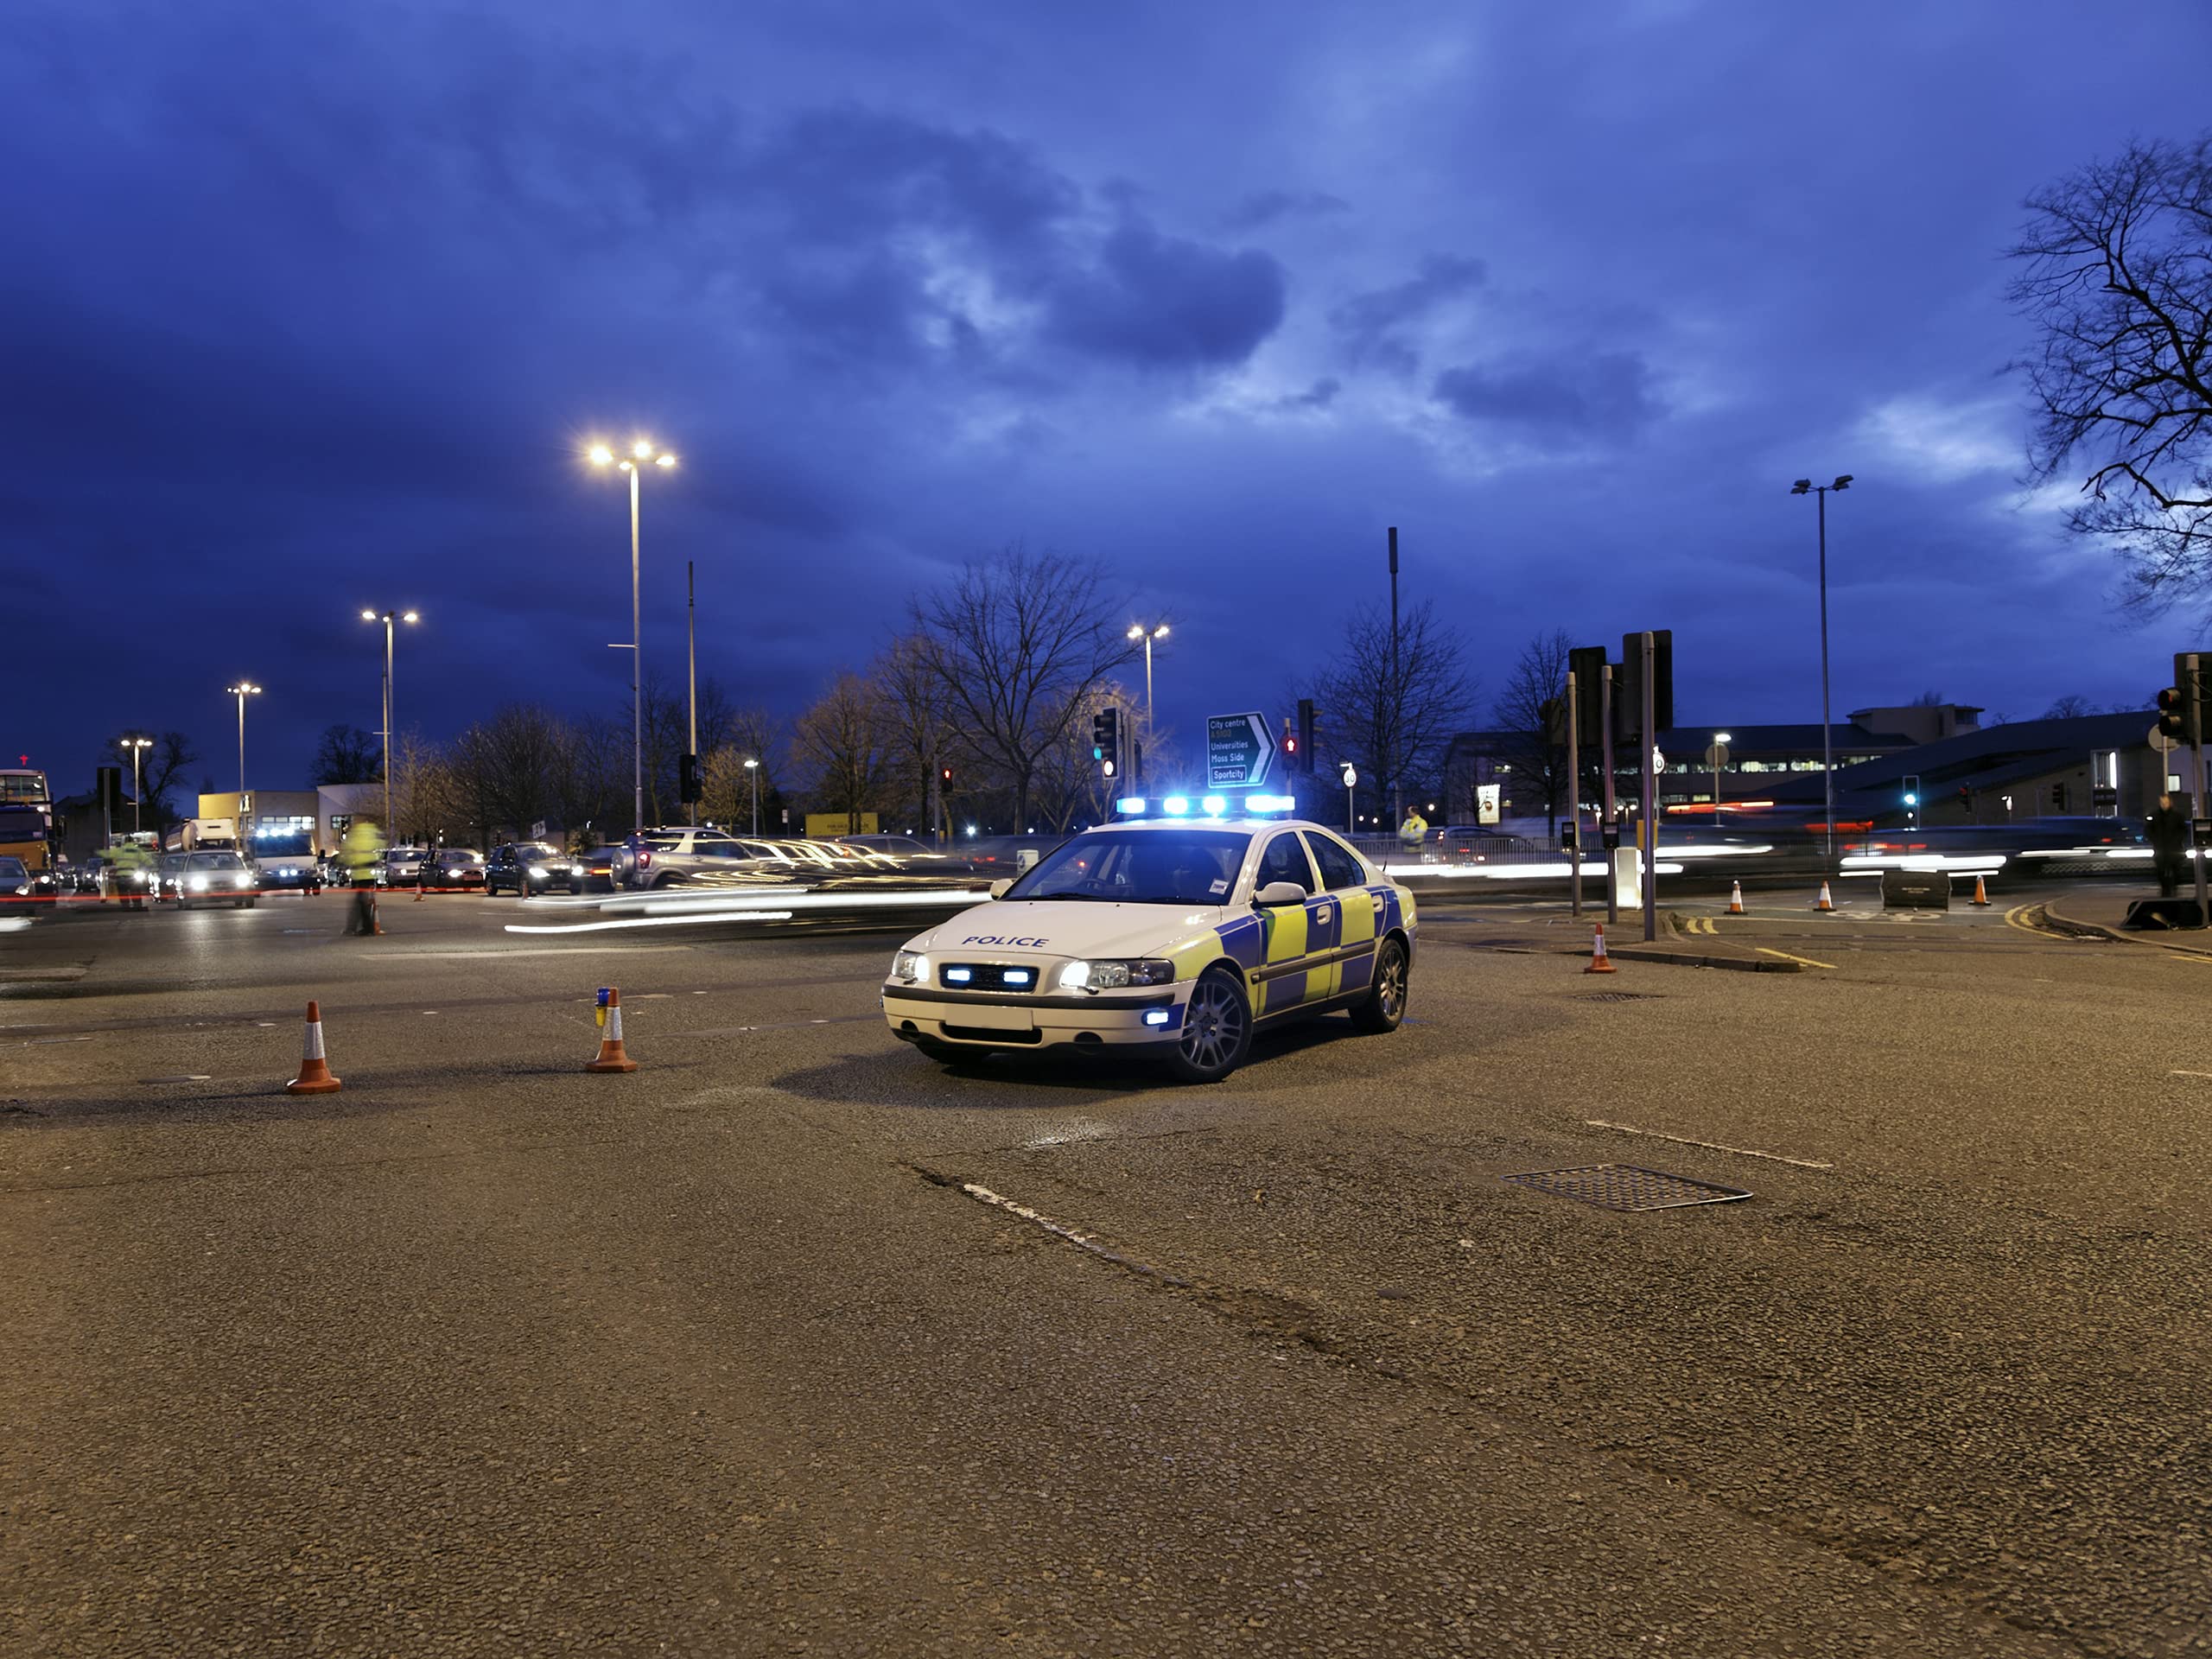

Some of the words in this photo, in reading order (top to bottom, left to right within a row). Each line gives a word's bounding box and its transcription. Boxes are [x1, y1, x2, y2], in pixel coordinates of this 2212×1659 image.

[1210, 719, 1224, 729] City
[1225, 718, 1246, 728] centre
[1211, 741, 1249, 751] Universities
[1211, 754, 1228, 763] Moss
[1230, 753, 1245, 762] Side
[1213, 770, 1244, 780] Sportcity
[962, 937, 1050, 947] POLICE
